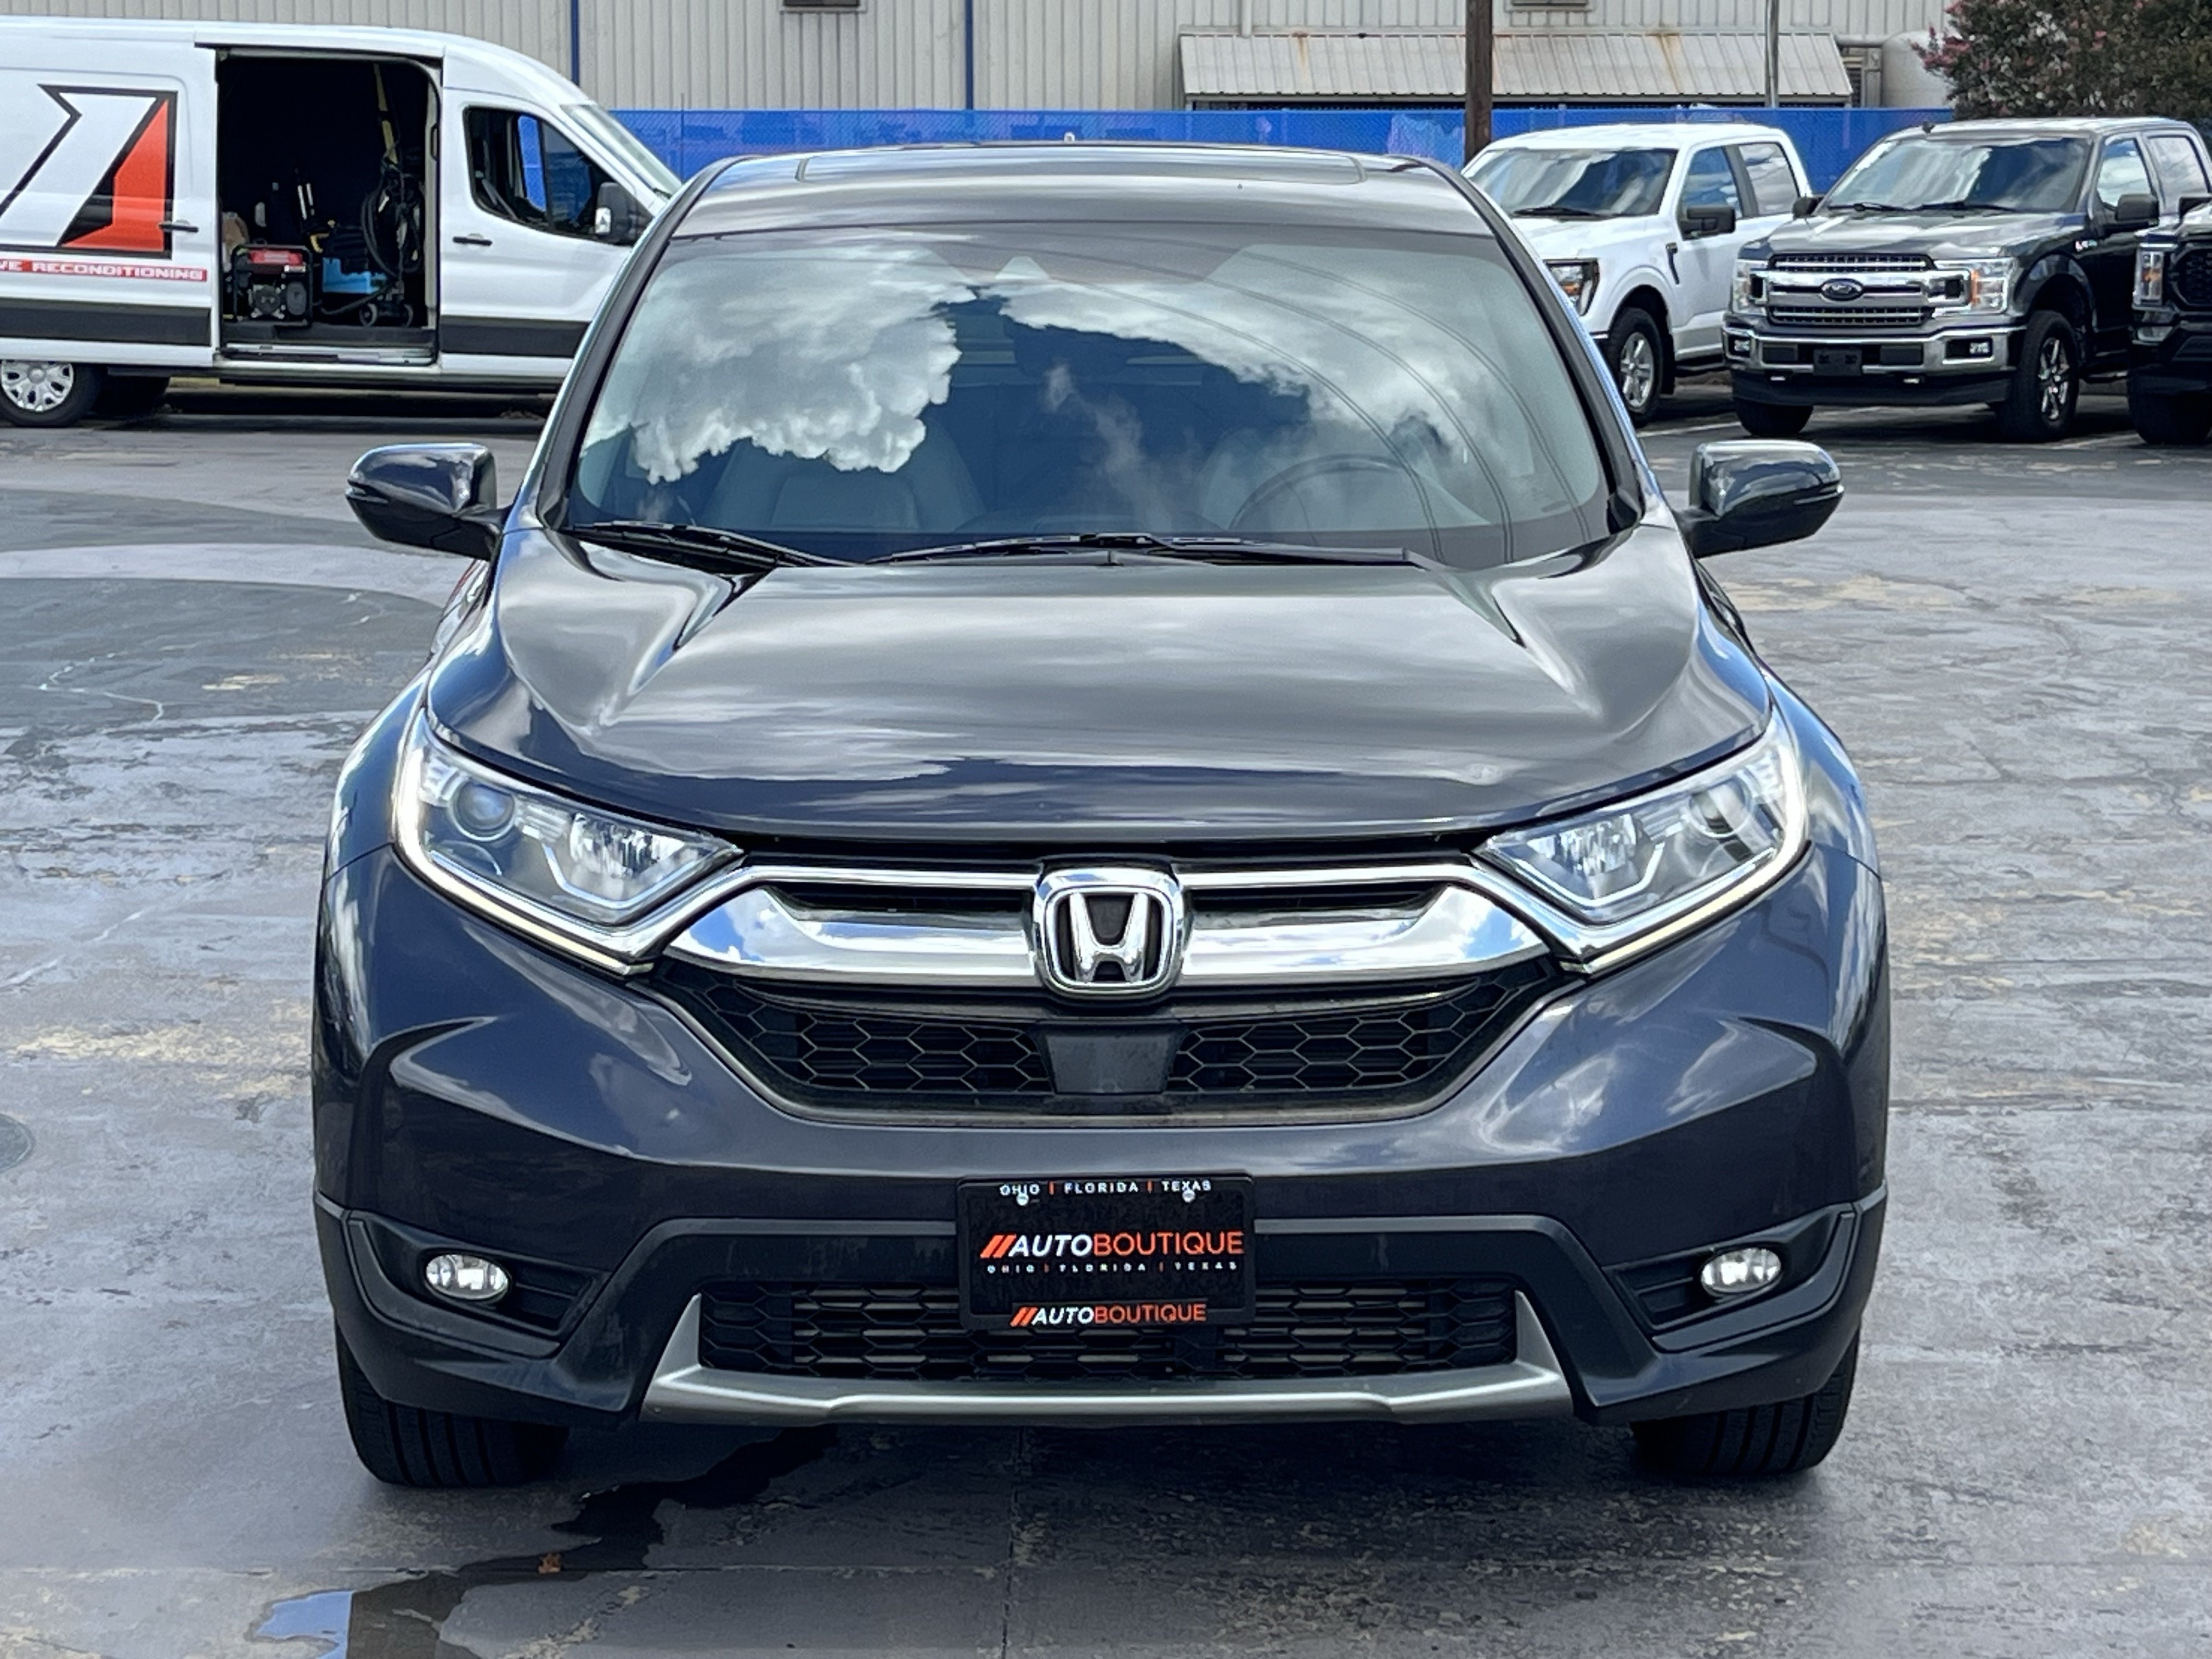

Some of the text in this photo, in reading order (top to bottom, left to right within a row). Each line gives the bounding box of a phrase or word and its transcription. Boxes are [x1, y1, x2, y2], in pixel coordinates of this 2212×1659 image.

[32, 263, 203, 280] RECONDITIONING
[999, 1180, 1211, 1196] OHIO FLORIDA TEXAS
[1008, 1231, 1244, 1257] AUTOBOUTIQUE
[1031, 1304, 1206, 1325] AUTOBOUTIQUE
